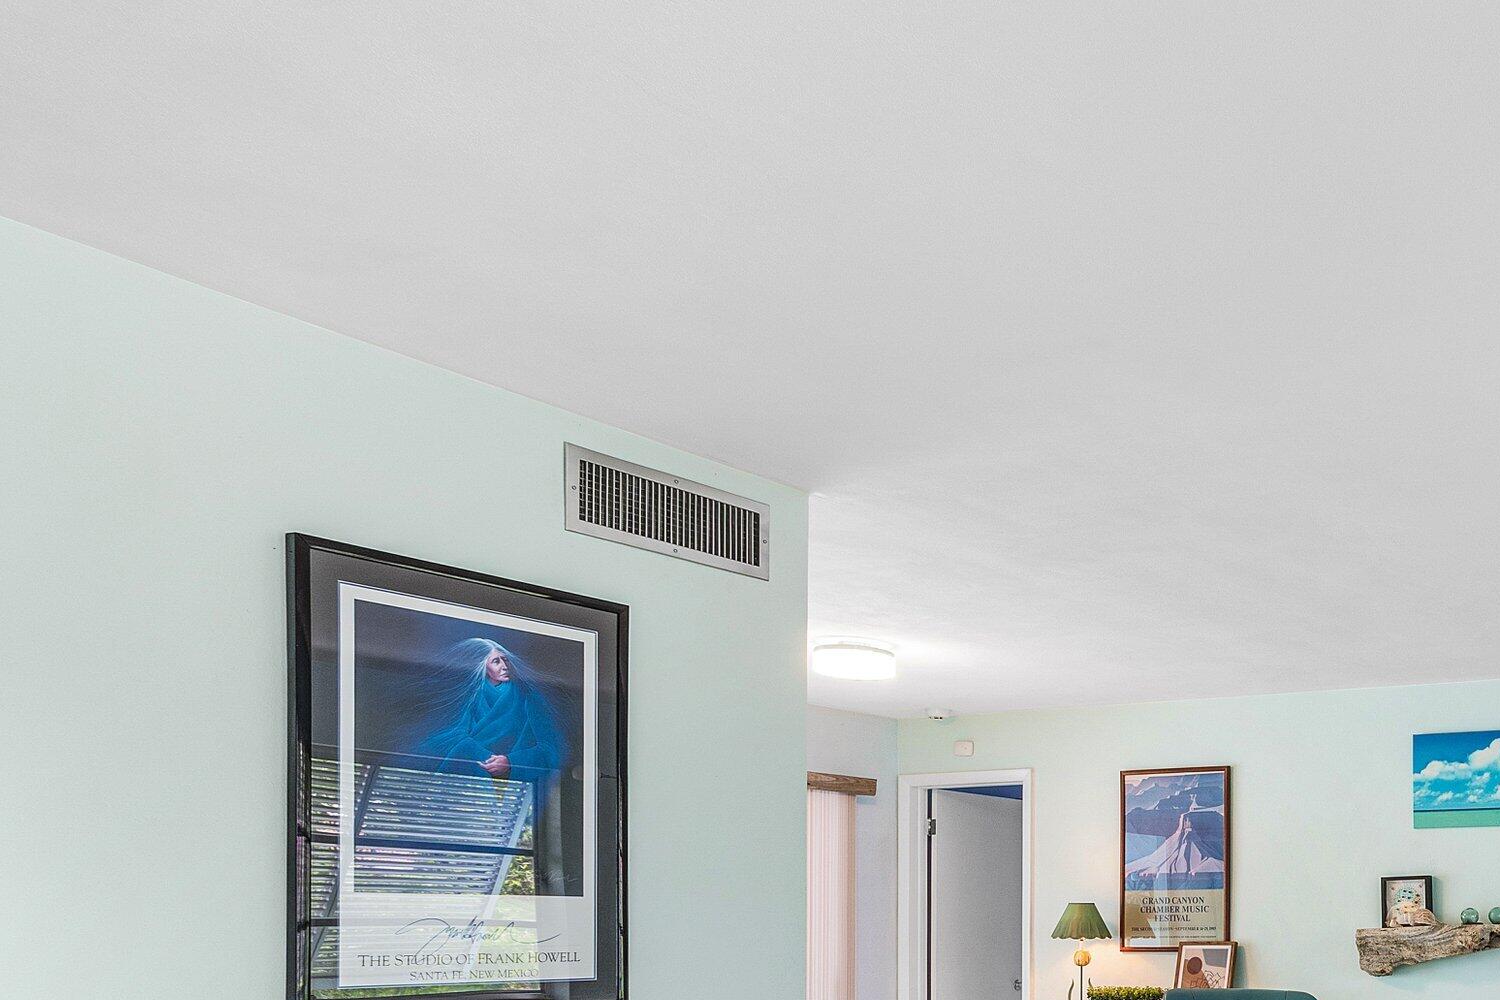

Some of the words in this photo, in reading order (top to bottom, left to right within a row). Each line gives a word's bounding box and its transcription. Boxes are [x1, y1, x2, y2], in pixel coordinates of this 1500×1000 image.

[1140, 905, 1180, 914] CHAMBER
[1181, 905, 1210, 913] MUSIC
[1154, 914, 1191, 922] FESTIVAL
[357, 954, 391, 967] THE
[394, 953, 453, 967] STUDIO
[456, 953, 477, 965] OF
[478, 952, 525, 965] FRANK
[528, 951, 582, 963] HOWELL
[409, 970, 449, 981] SANTA
[469, 969, 495, 979] NEW
[497, 968, 539, 978] MEXICO
